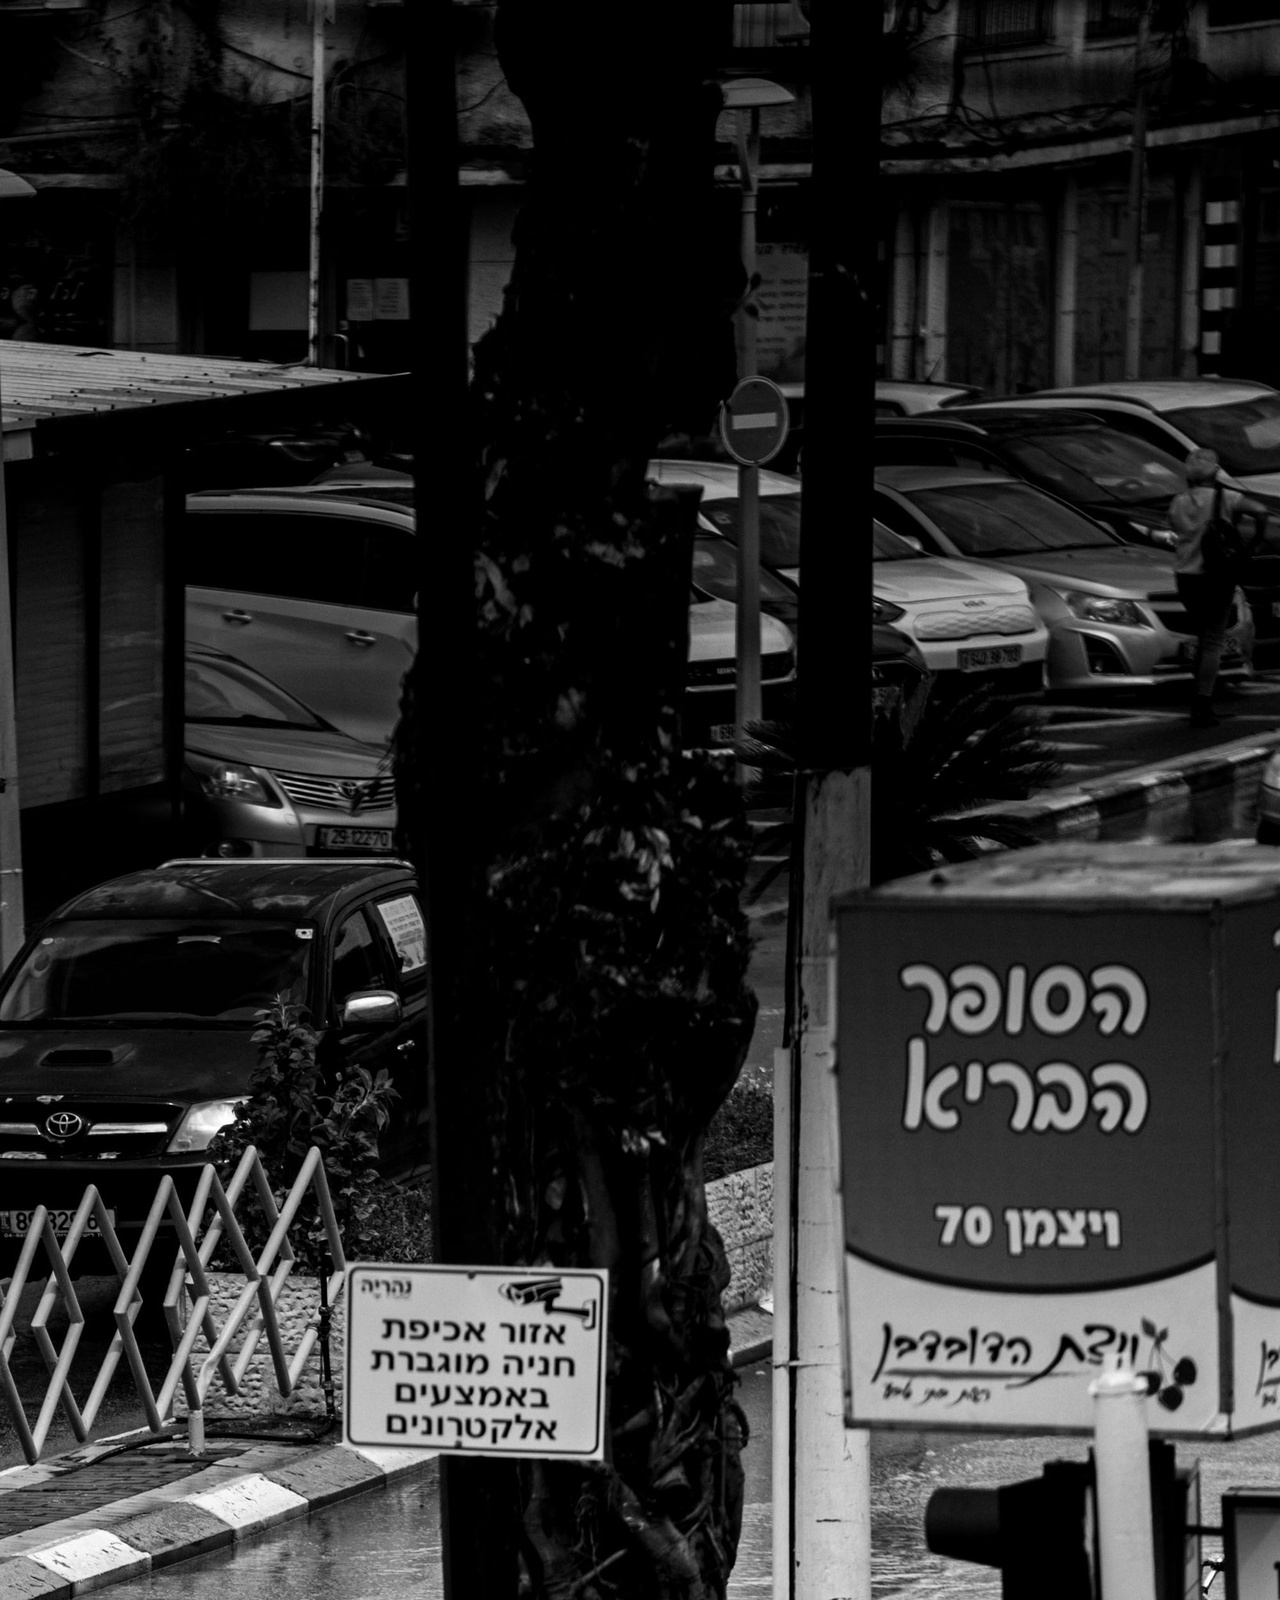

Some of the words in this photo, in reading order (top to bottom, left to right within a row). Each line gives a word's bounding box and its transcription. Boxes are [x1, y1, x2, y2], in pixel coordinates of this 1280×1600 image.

[899, 962, 1150, 1036] הסופר
[901, 1036, 1150, 1133] הבריא
[933, 1204, 994, 1247] 70
[1003, 1207, 1122, 1256] ויצמן
[381, 1318, 486, 1343] אכיפת
[499, 1321, 566, 1345] אזור
[370, 1350, 489, 1375] מוגברת
[502, 1355, 575, 1377] חניה
[871, 1321, 1032, 1384] הדובדבן
[395, 1383, 549, 1409] באמצעים
[386, 1413, 558, 1444] אלקטרונים
